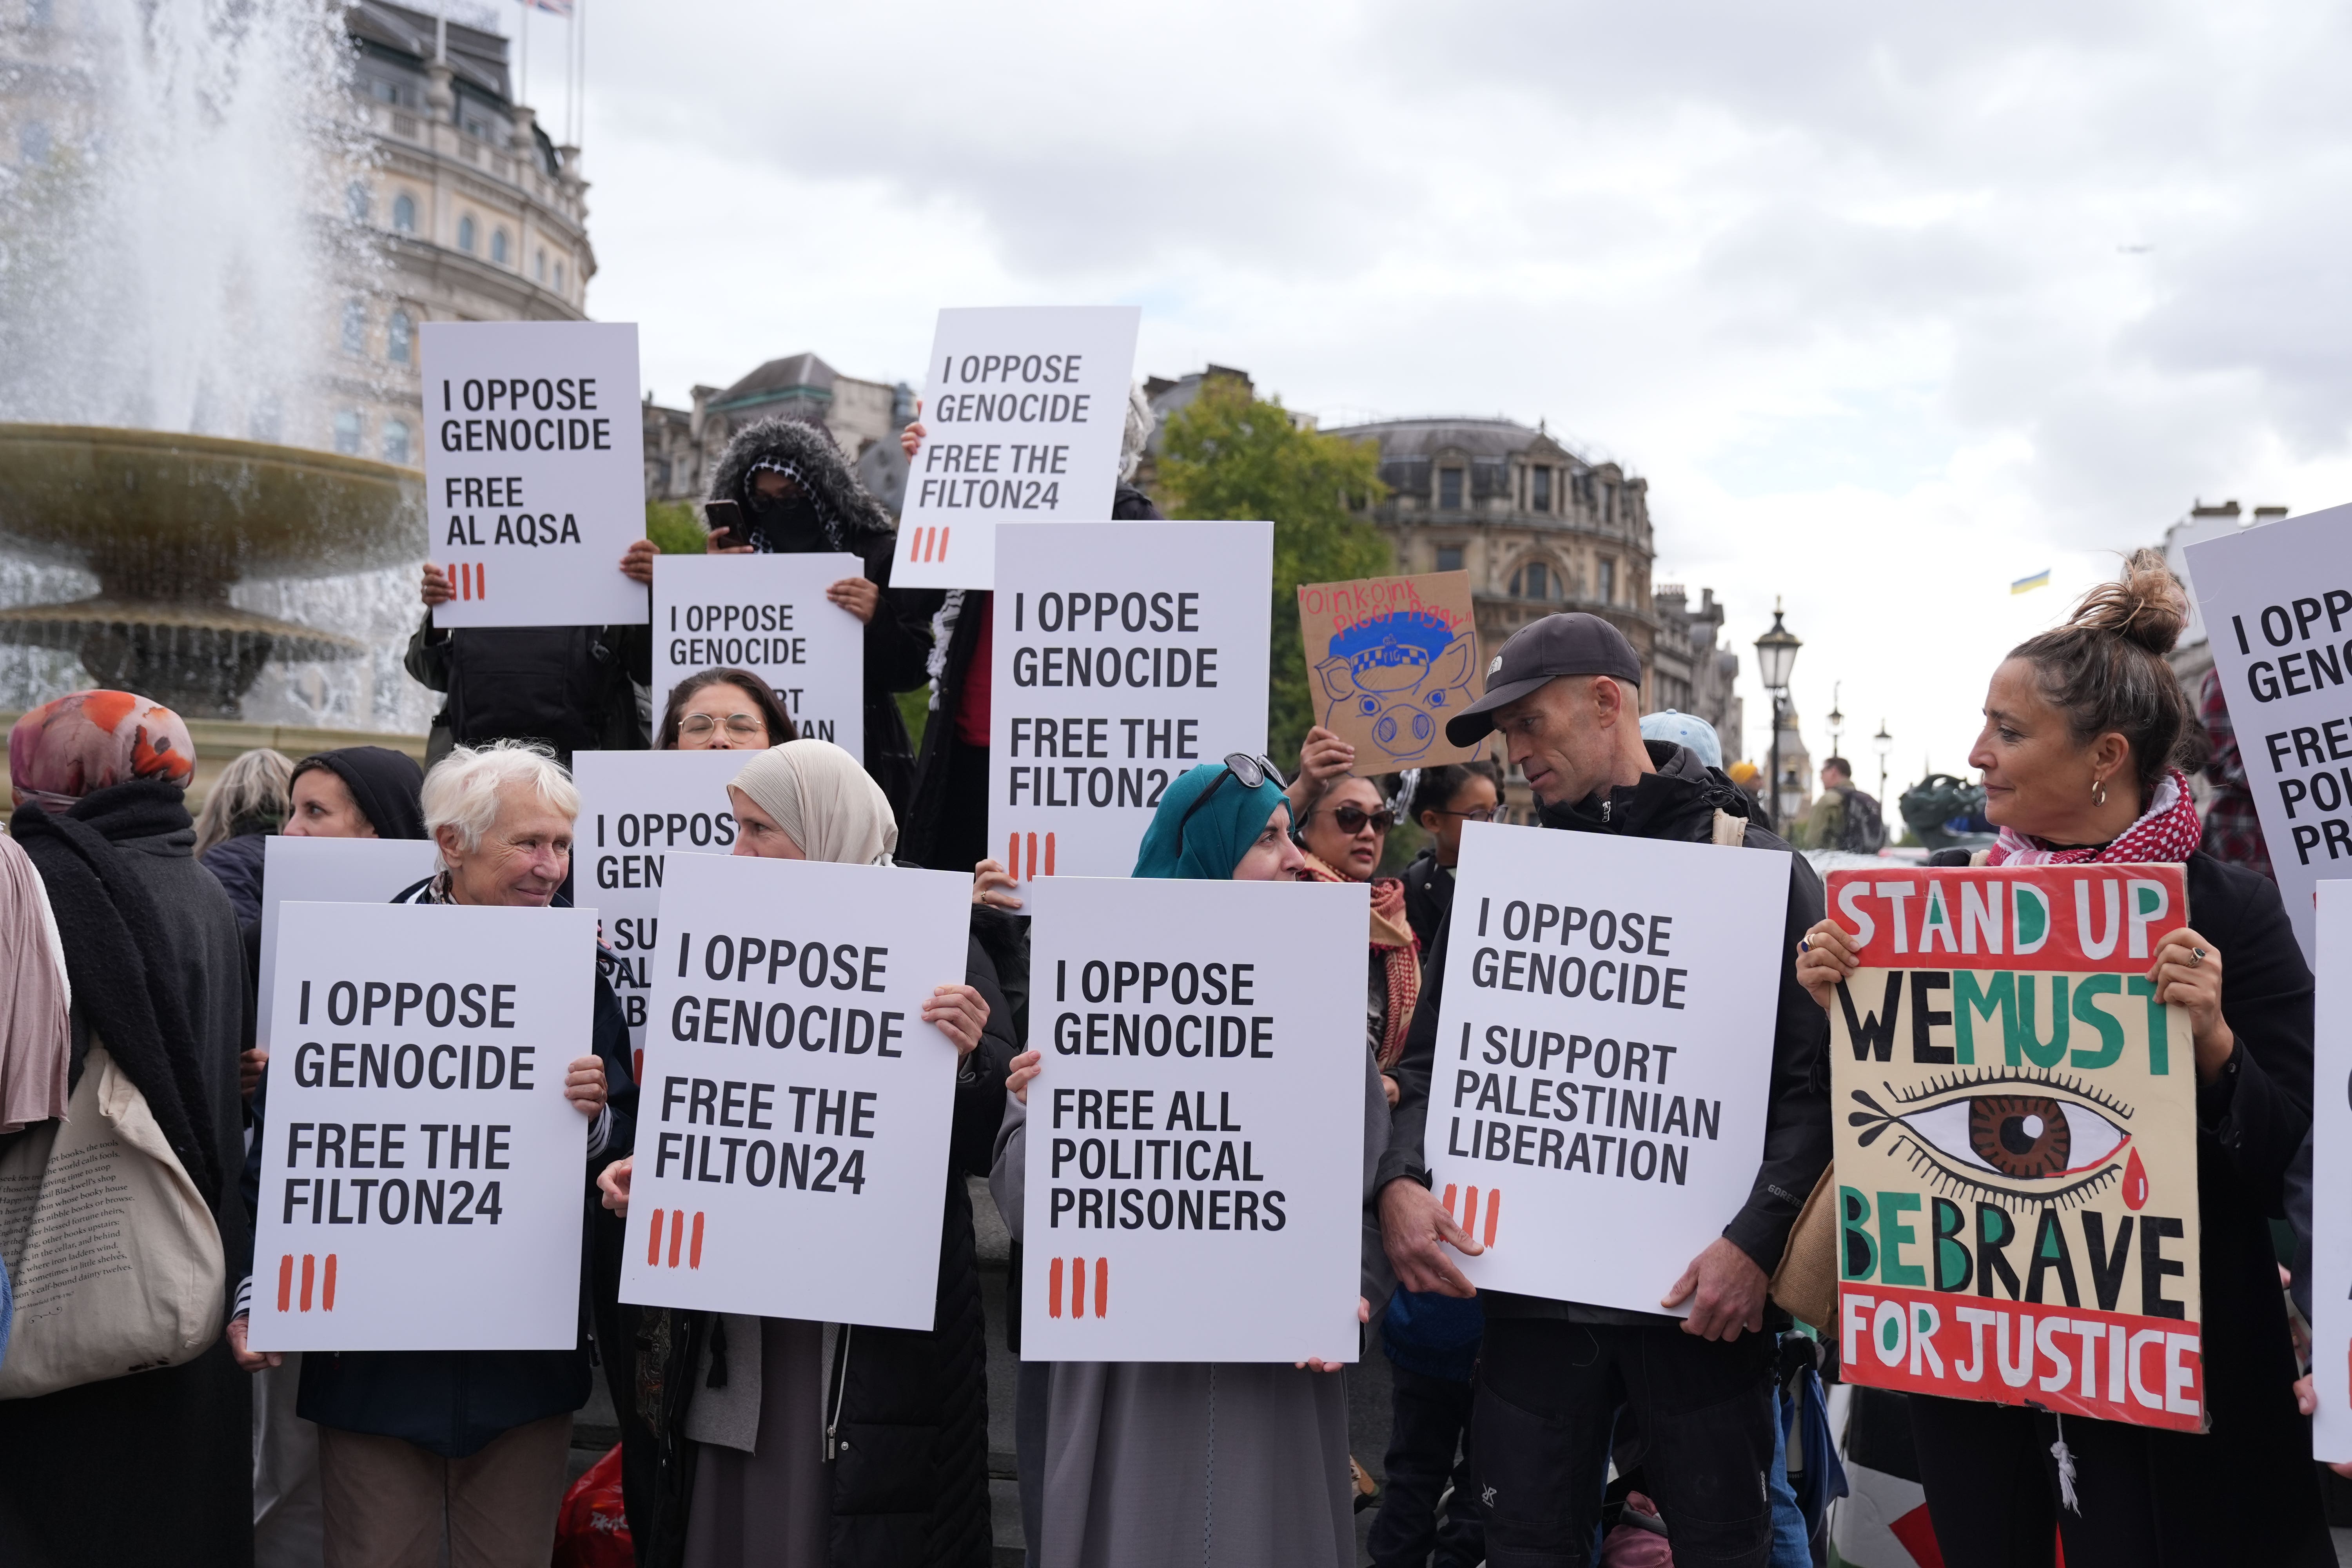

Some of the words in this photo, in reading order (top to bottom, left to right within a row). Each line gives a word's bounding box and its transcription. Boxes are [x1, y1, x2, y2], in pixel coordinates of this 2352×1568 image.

[944, 357, 951, 382] I
[962, 356, 1081, 382] OPPOSE
[444, 380, 450, 411] I
[463, 379, 597, 411] OPPOSE
[937, 395, 1089, 421] GENOCIDE
[442, 419, 611, 452] GENOCIDE
[927, 445, 1000, 472] FREE
[1012, 446, 1068, 473] THE
[446, 477, 523, 508] FREE
[920, 480, 1058, 509] FILTON24
[447, 515, 485, 545] AL
[495, 514, 581, 547] AQSA
[671, 606, 676, 631] I
[687, 605, 793, 632] OPPOSE
[1016, 593, 1023, 631] I
[1039, 592, 1198, 632] OPPOSE
[2232, 615, 2250, 655] I
[2261, 590, 2352, 647] OPP
[671, 639, 806, 665] GENOCIDE
[1014, 647, 1217, 687] GENOCIDE
[1011, 718, 1107, 757] FREE
[1121, 719, 1198, 759] THE
[2265, 717, 2352, 773] FRE
[1010, 767, 1190, 807] FILTON2
[598, 815, 604, 847] I
[618, 813, 740, 847] OPPOS
[1478, 898, 1489, 936] I
[1504, 901, 1672, 956] OPPOSE
[1838, 880, 2050, 955] STAND
[2074, 879, 2169, 959] UP
[678, 933, 690, 977] I
[706, 935, 888, 993] OPPOSE
[1057, 960, 1065, 1002] I
[1082, 960, 1254, 1005] OPPOSE
[1473, 947, 1687, 1009] GENOCIDE
[299, 981, 310, 1024] I
[328, 981, 515, 1028] OPPOSE
[672, 996, 904, 1058] GENOCIDE
[1055, 1013, 1273, 1058] GENOCIDE
[295, 1042, 535, 1090] GENOCIDE
[1460, 1022, 1471, 1060] I
[1483, 1025, 1677, 1084] SUPPORT
[662, 1076, 775, 1130] FREE
[789, 1086, 877, 1138] THE
[1053, 1089, 1153, 1130] FREE
[1166, 1091, 1241, 1131] ALL
[1454, 1069, 1720, 1140] PALESTINIAN
[59, 1159, 80, 1172] world
[81, 1154, 98, 1165] calls
[61, 1148, 85, 1160] books,
[86, 1143, 98, 1152] the
[100, 1140, 118, 1148] tools
[287, 1123, 405, 1168] FREE
[421, 1124, 510, 1169] THE
[656, 1132, 865, 1194] FILTON24
[1052, 1138, 1263, 1181] POLITICAL
[1448, 1117, 1688, 1185] LIBERATION
[43, 1178, 66, 1189] giving
[68, 1171, 83, 1181] time
[94, 1164, 111, 1173] stop
[55, 1178, 96, 1195] Blackwell's
[98, 1174, 116, 1184] shop
[55, 1195, 78, 1207] whose
[80, 1189, 103, 1200] booky
[105, 1184, 128, 1193] house
[47, 1209, 69, 1222] nibble
[71, 1202, 93, 1213] books
[283, 1179, 502, 1225] FILTON24
[1051, 1188, 1285, 1231] PRISONERS
[42, 1235, 63, 1245] other
[64, 1228, 87, 1239] books
[44, 1220, 70, 1233] blessed
[72, 1213, 99, 1224] fortune
[27, 1262, 50, 1273] where
[52, 1258, 67, 1266] iron
[69, 1249, 95, 1260] ladders
[41, 1249, 53, 1258] the
[78, 1238, 92, 1246] and
[94, 1230, 120, 1241] behind
[29, 1268, 69, 1285] sometimes
[80, 1259, 96, 1269] little
[36, 1276, 77, 1293] calf-bound
[79, 1270, 101, 1281] dainty
[1842, 1294, 1944, 1379] FOR
[1955, 1306, 2200, 1416] JUSTICE
